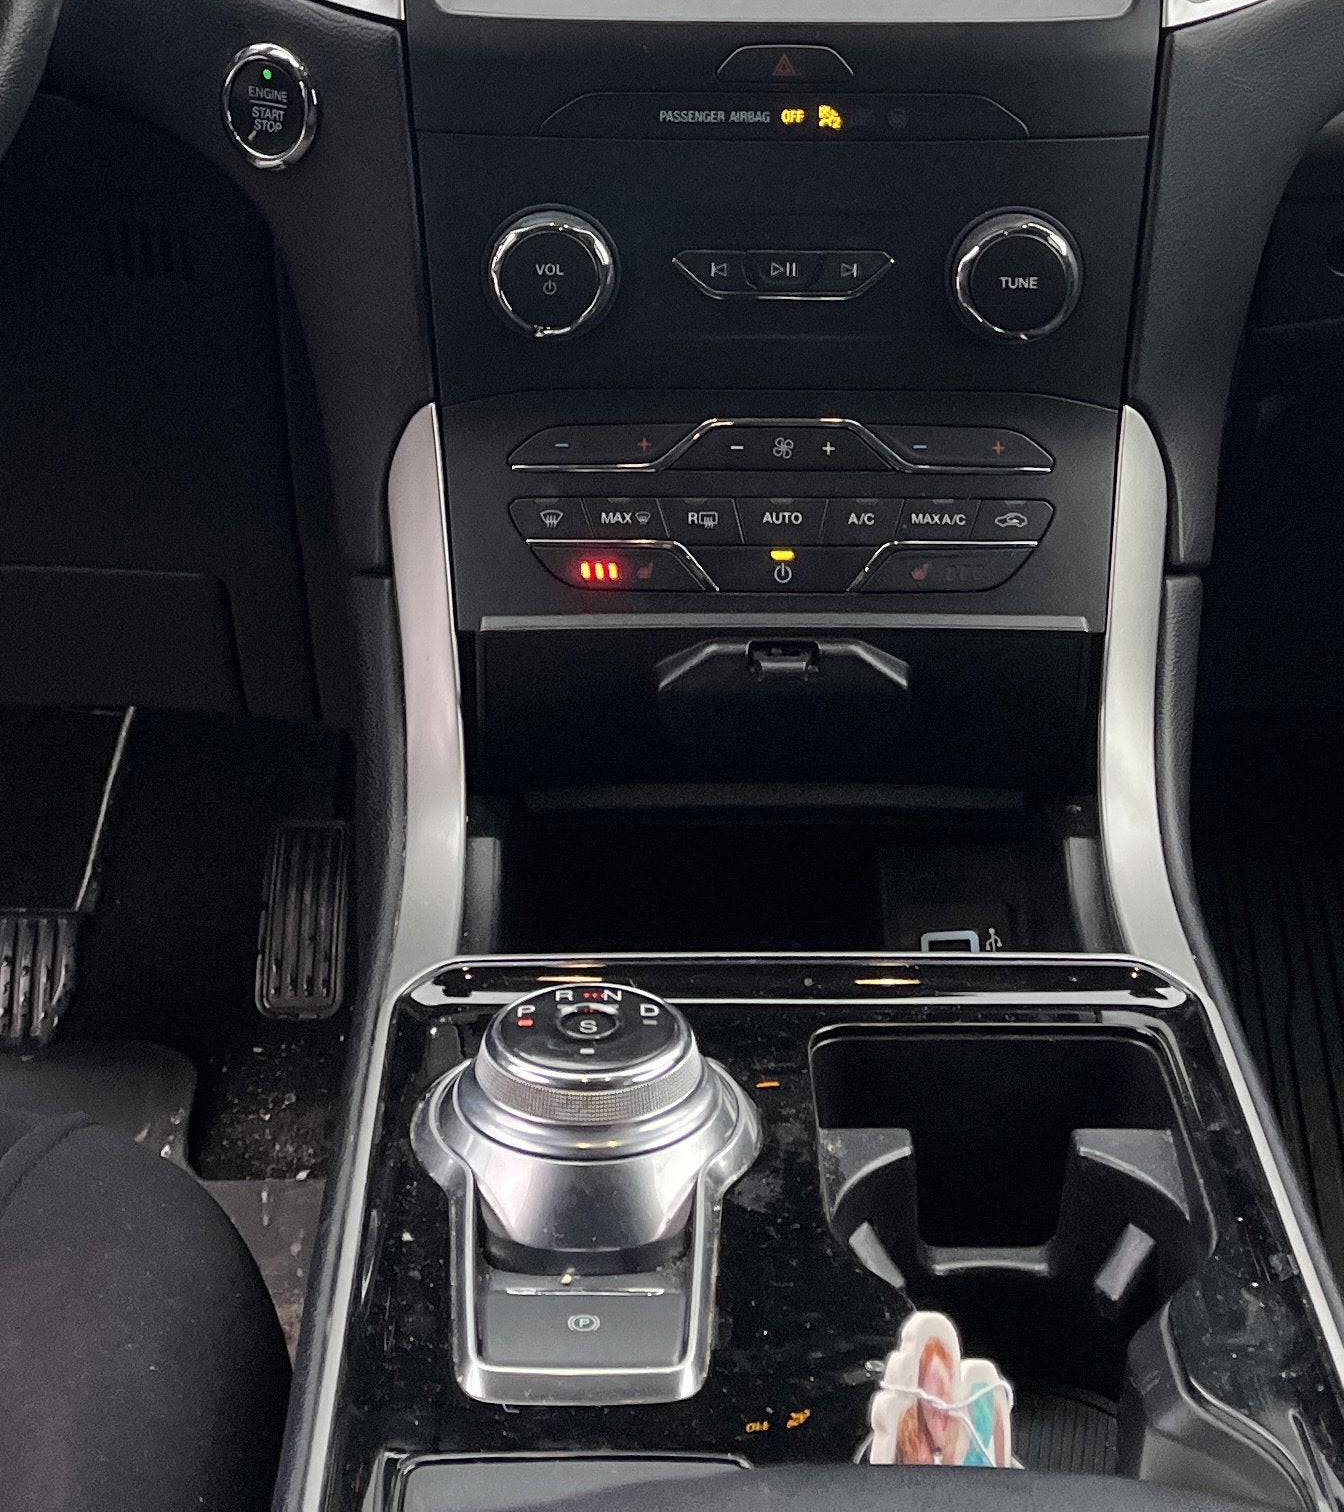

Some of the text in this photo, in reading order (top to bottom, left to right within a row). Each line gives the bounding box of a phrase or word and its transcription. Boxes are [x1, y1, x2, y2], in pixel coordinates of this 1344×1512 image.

[248, 86, 288, 103] ENGINE
[251, 106, 285, 122] START
[659, 108, 805, 124] PASSENGER AIRBAG OFF
[254, 118, 283, 133] STOP
[535, 263, 565, 276] VOL
[999, 276, 1038, 290] TUNE
[600, 512, 633, 526] MAX
[688, 512, 700, 526] R
[762, 512, 803, 526] AUTO
[847, 512, 875, 526] A/C
[556, 990, 574, 1001] R
[604, 990, 622, 1001] N
[517, 1004, 536, 1017] P
[640, 1004, 660, 1016] D
[579, 1020, 598, 1033] S
